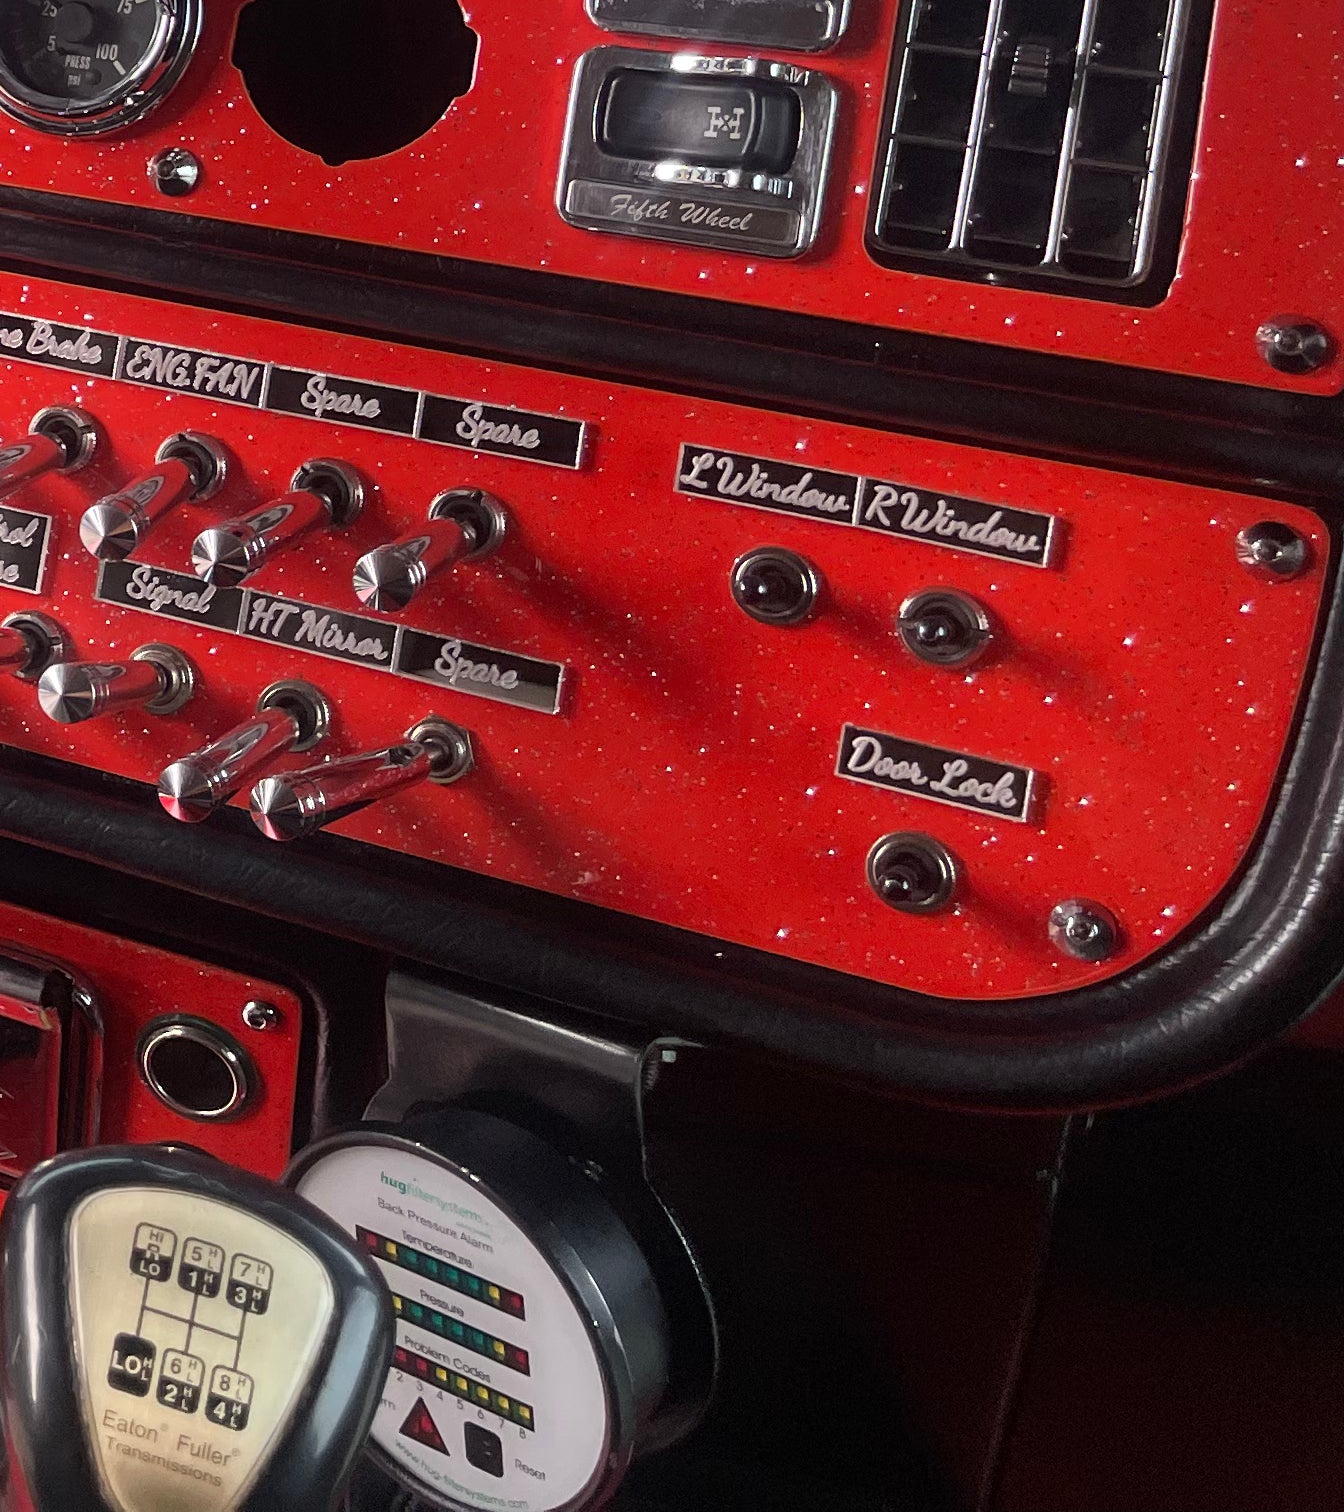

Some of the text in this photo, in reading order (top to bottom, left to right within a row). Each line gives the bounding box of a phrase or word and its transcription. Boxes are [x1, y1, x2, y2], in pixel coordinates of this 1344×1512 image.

[65, 55, 91, 69] PRESS
[610, 194, 753, 232] Fifth Wheel
[26, 321, 102, 365] Brake
[126, 346, 260, 399] ENG FAN
[301, 376, 381, 418] Spare
[456, 404, 540, 449] Spare
[679, 453, 850, 514] L Window
[864, 484, 1040, 554] R Window
[126, 567, 217, 614] Signal
[249, 598, 389, 661] HT Mirror
[434, 639, 518, 690] Spare
[847, 736, 1017, 809] Door Lock
[149, 1229, 164, 1242] HI
[378, 1197, 404, 1217] Back
[407, 1210, 457, 1238] Pressure
[460, 1232, 494, 1253] Alarm
[140, 1260, 160, 1275] LO
[192, 1247, 202, 1261] 5
[402, 1229, 474, 1268] Temperature
[189, 1271, 198, 1287] 1
[240, 1262, 251, 1277] 7
[234, 1287, 246, 1303] 3
[420, 1289, 464, 1317] Pressure
[112, 1350, 142, 1374] LO
[170, 1358, 182, 1374] 6
[404, 1335, 491, 1383] Problem Codes
[164, 1384, 178, 1403] 2
[219, 1374, 230, 1391] 8
[213, 1401, 226, 1420] 4
[105, 1436, 222, 1487] Transmissions
[514, 1458, 546, 1481] Reset
